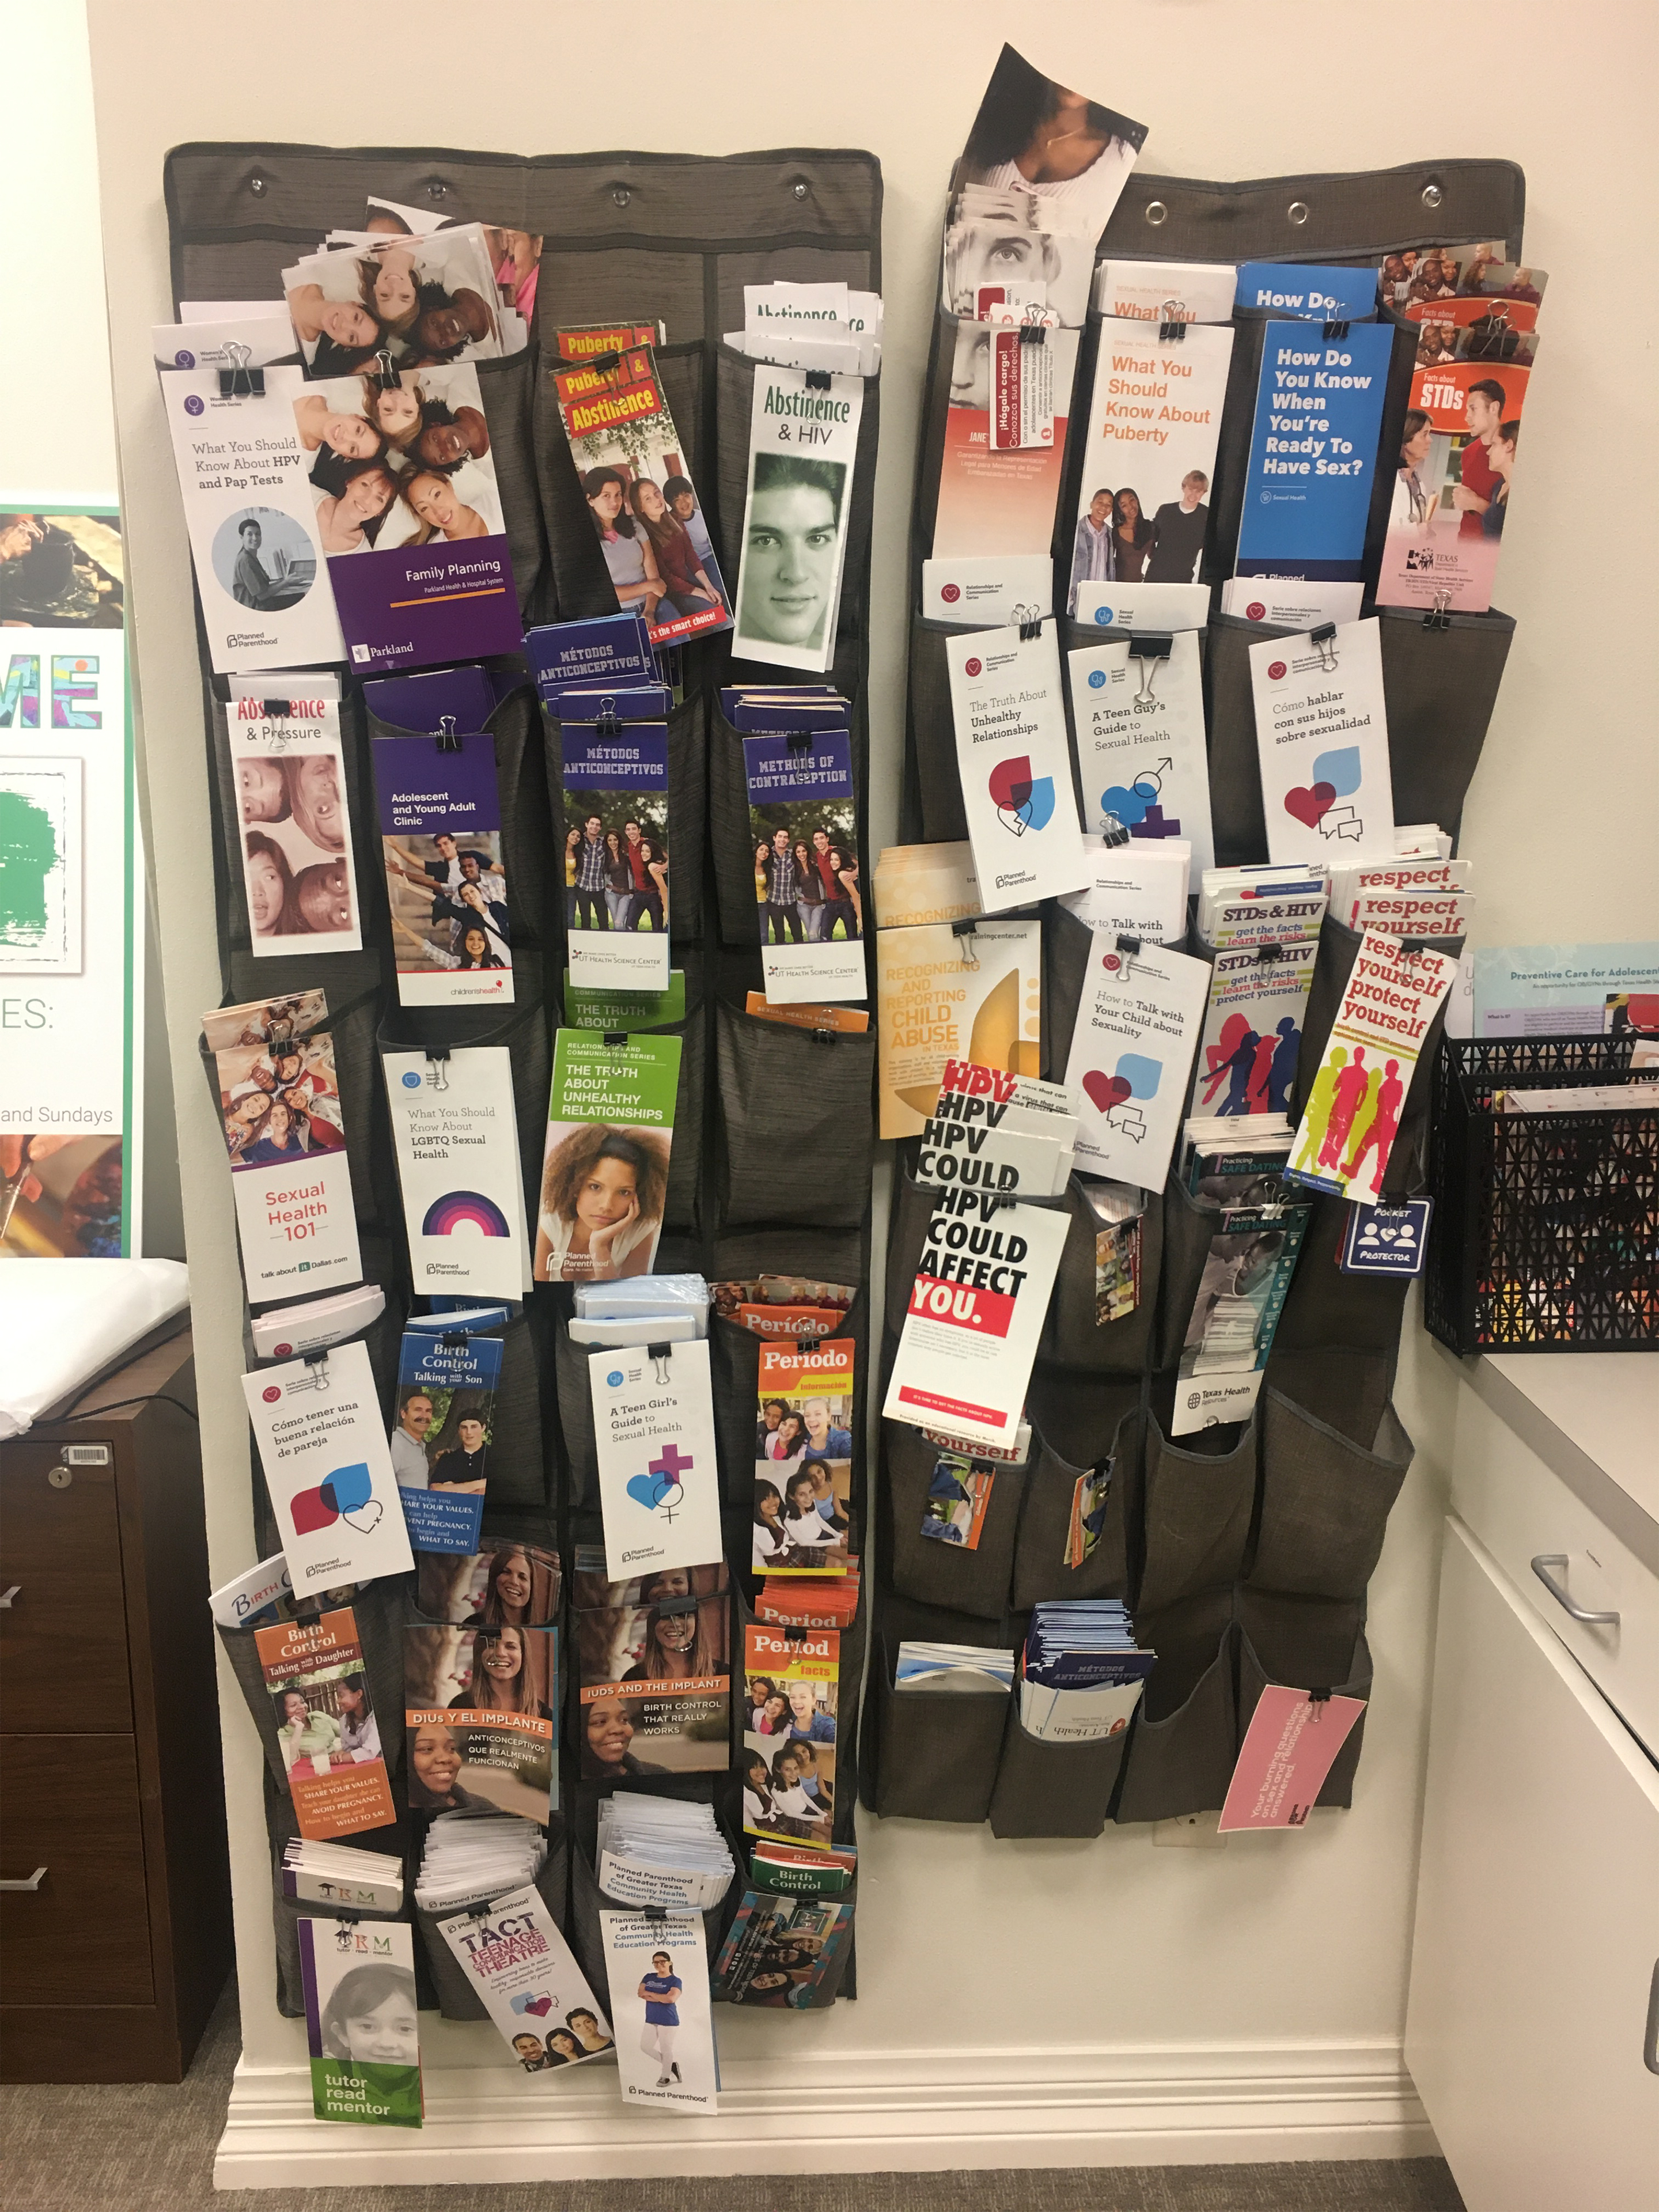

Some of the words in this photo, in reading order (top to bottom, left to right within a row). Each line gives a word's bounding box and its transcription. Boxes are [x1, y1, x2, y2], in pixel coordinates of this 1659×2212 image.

[1009, 332, 1018, 381] derechos.
[1112, 355, 1156, 374] What
[1161, 360, 1192, 377] You
[1277, 350, 1320, 366] How
[1325, 350, 1352, 366] Do
[1002, 350, 1010, 385] cargo!
[1275, 372, 1310, 388] You
[1314, 372, 1372, 389] Know
[1424, 373, 1438, 382] Facts
[1440, 375, 1456, 383] about
[1108, 379, 1168, 398] Should
[1421, 382, 1464, 410] STDs
[572, 388, 654, 430] Abstinence
[764, 385, 850, 423] Abstinence
[999, 388, 1009, 430] ¡Hágale
[1272, 393, 1325, 410] When
[1106, 402, 1154, 419] Know
[1158, 406, 1210, 424] About
[778, 425, 791, 441] &
[799, 424, 833, 445] HIV
[1103, 424, 1169, 445] Puberty
[192, 443, 226, 454] What
[229, 442, 252, 452] You
[255, 437, 297, 450] Should
[1266, 437, 1326, 457] Ready
[1330, 438, 1353, 454] To
[196, 461, 229, 471] Know
[234, 458, 270, 469] About
[273, 455, 301, 467] HPV
[1263, 459, 1310, 475] Have
[1315, 460, 1362, 476] Sex?
[199, 477, 222, 488] and
[225, 477, 247, 488] Pap
[251, 475, 283, 485] Tests
[1435, 553, 1459, 563] TEXAS
[406, 566, 444, 582] Family
[448, 560, 501, 576] Planning
[424, 585, 444, 593] Parkland
[467, 579, 486, 589] Hospital
[487, 577, 503, 586] System
[370, 643, 414, 657] Parkland
[970, 700, 987, 712] The
[990, 695, 1016, 709] Truth
[1018, 689, 1047, 704] About
[1272, 700, 1304, 715] Cómo
[1307, 691, 1344, 706] hablar
[971, 710, 1021, 728] Unhealthy
[1274, 717, 1294, 729] con
[1297, 711, 1315, 725] sus
[1317, 706, 1346, 722] hijos
[247, 728, 257, 740] &
[263, 727, 321, 740] Pressure
[972, 722, 1038, 744] Relationships
[1275, 730, 1306, 745] sobre
[1309, 715, 1371, 738] sexualidad
[587, 745, 639, 759] MÉTODOS
[563, 763, 664, 775] ANTICONCEPTIVOS
[759, 758, 815, 772] METHODS
[820, 755, 834, 767] OF
[749, 770, 847, 789] CONTRACEPTION
[392, 792, 449, 802] Adolescent
[393, 805, 411, 813] and
[414, 805, 446, 816] Young
[449, 802, 476, 812] Adult
[394, 817, 422, 825] Clinic
[1003, 870, 1025, 881] Planned
[1005, 874, 1037, 888] Parenthood
[1222, 907, 1267, 922] STDs
[1269, 906, 1285, 918] &
[1287, 902, 1323, 919] HIV
[1236, 927, 1255, 939] get
[1257, 925, 1274, 935] the
[1276, 923, 1303, 934] facts
[1363, 935, 1444, 975] respect
[886, 960, 980, 979] RECOGNIZING
[1358, 956, 1446, 998] yourself
[1511, 971, 1562, 980] Preventive
[1565, 970, 1588, 978] Care
[1592, 968, 1605, 976] for
[902, 979, 931, 993] AND
[1216, 992, 1256, 1006] protect
[1258, 985, 1303, 1002] yourself
[887, 990, 965, 1009] REPORTING
[1347, 980, 1421, 1014] protect
[3, 999, 52, 1029] ES:
[1097, 991, 1120, 1003] How
[1122, 998, 1133, 1007] to
[1136, 1001, 1158, 1016] Talk
[1161, 1009, 1184, 1023] with
[892, 1005, 951, 1029] CHILD
[1094, 1004, 1119, 1018] Your
[1122, 1012, 1152, 1027] Child
[1153, 1021, 1183, 1037] about
[1343, 1000, 1426, 1039] yourself
[892, 1025, 959, 1048] ABUSE
[1091, 1017, 1142, 1039] Sexuality
[564, 1078, 609, 1090] ABOUT
[563, 1091, 641, 1105] UNHEALTHY
[1, 1107, 32, 1122] and
[39, 1107, 112, 1126] Sundays
[562, 1105, 662, 1120] RELATIONSHIPS
[266, 1181, 325, 1206] Sexual
[268, 1202, 327, 1225] Health
[1374, 1207, 1411, 1218] POCKET
[284, 1222, 316, 1241] 101
[1228, 1220, 1249, 1232] SAFE
[1252, 1219, 1286, 1229] DATING
[927, 1218, 1027, 1262] COULD
[1360, 1251, 1411, 1262] PROTECTOR
[919, 1249, 1027, 1297] AFFECT
[912, 1280, 982, 1324] YOU.
[745, 1313, 830, 1334] Período
[1202, 1397, 1229, 1406] Resources
[1203, 1389, 1222, 1397] Texas
[1225, 1387, 1250, 1396] Health
[271, 1416, 304, 1433] Cómo
[306, 1408, 335, 1422] tener
[338, 1402, 358, 1413] una
[275, 1428, 308, 1445] buena
[310, 1415, 355, 1435] relación
[278, 1448, 290, 1459] de
[294, 1436, 328, 1455] pareja
[754, 1635, 829, 1656] Period
[801, 1665, 830, 1676] facts
[618, 1684, 642, 1693] AND
[646, 1682, 668, 1691] THE
[671, 1679, 721, 1690] IMPLANT
[644, 1703, 672, 1711] BIRTH
[675, 1701, 721, 1710] CONTROL
[413, 1713, 444, 1723] DIUs
[448, 1713, 458, 1722] Y
[461, 1713, 477, 1722] EL
[482, 1714, 545, 1733] IMPLANTE
[644, 1715, 669, 1723] THAT
[672, 1713, 707, 1721] REALLY
[644, 1726, 680, 1735] WORKS
[1251, 1790, 1265, 1818] Your
[1260, 1752, 1281, 1793] burning
[1278, 1702, 1304, 1751] questions
[609, 1862, 641, 1877] Planned
[644, 1873, 692, 1884] Parenthood
[627, 1876, 658, 1887] Greater
[779, 1870, 812, 1881] Birth
[770, 1877, 821, 1890] Control
[459, 1912, 536, 1952] TACT
[325, 2073, 368, 2089] tutor
[327, 2087, 366, 2100] read
[327, 2099, 390, 2116] mentor
